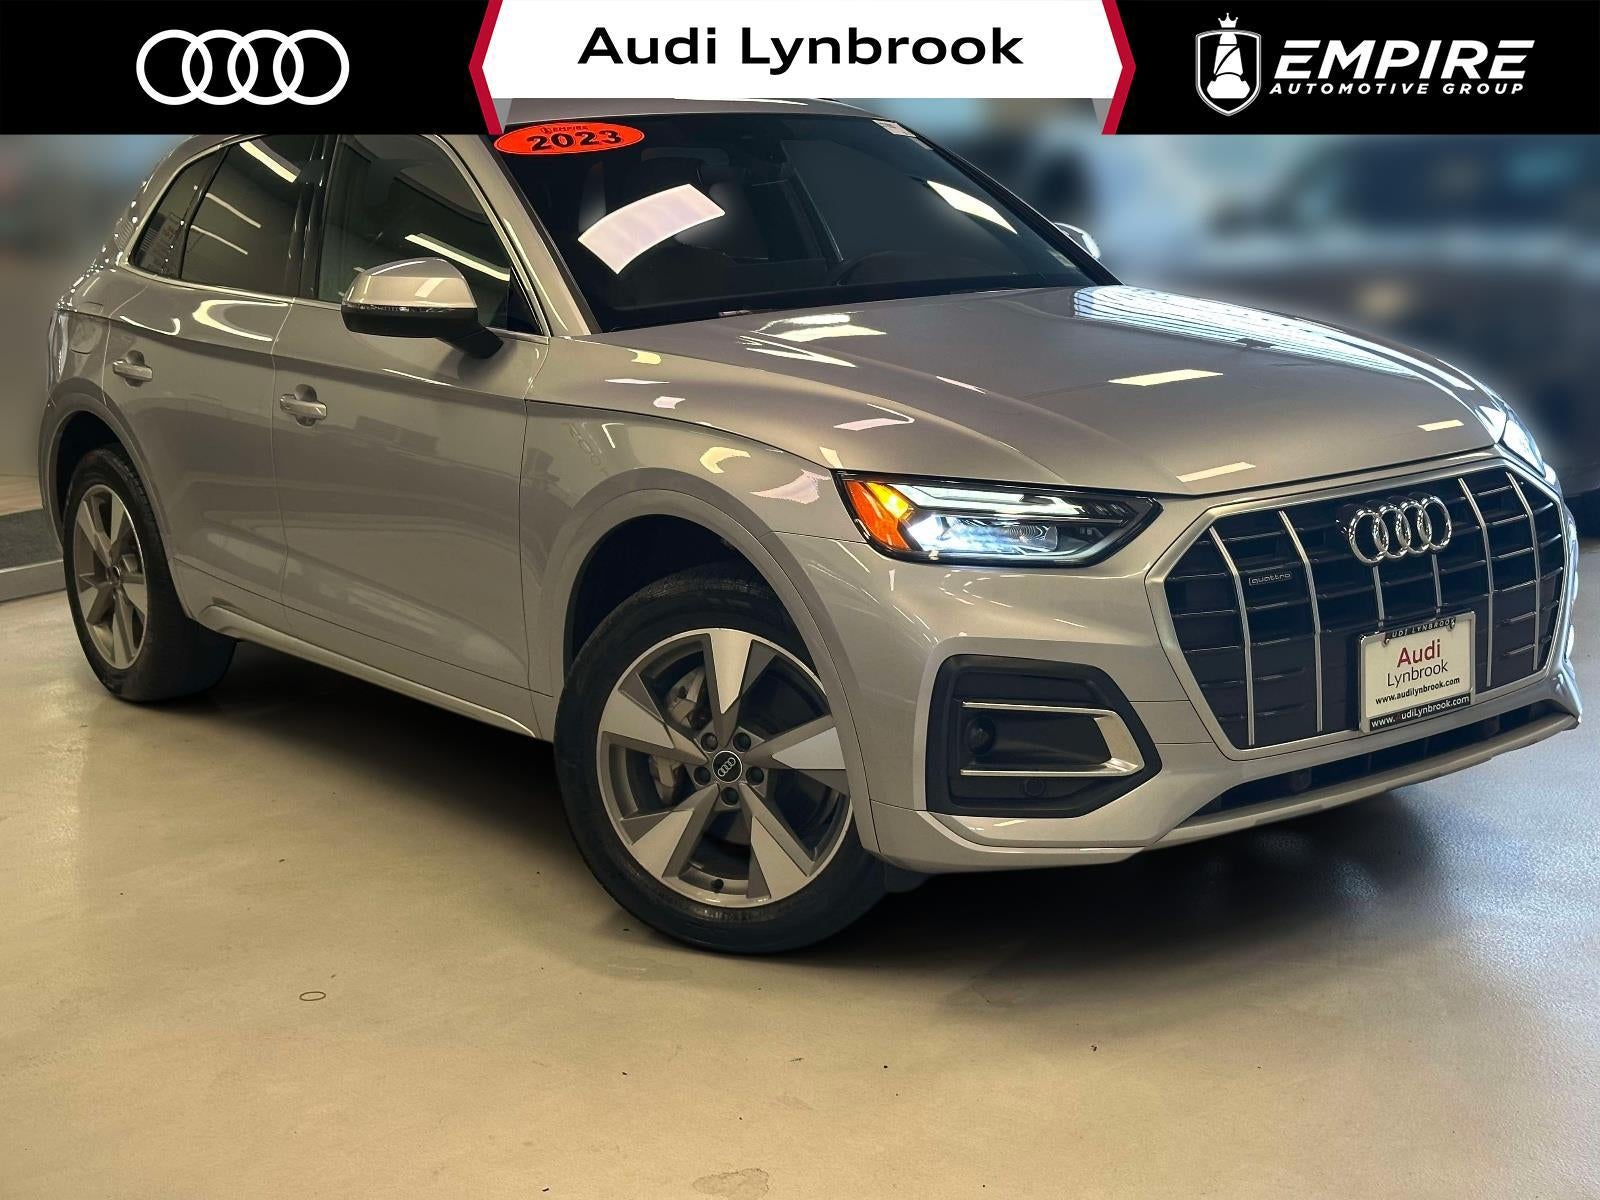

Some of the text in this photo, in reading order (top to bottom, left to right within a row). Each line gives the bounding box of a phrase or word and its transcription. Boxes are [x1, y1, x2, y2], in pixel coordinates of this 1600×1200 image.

[526, 130, 622, 151] 2023
[1250, 573, 1291, 585] quattro
[1397, 639, 1441, 667] Audi
[1387, 659, 1449, 688] Lynbrook
[1375, 677, 1460, 705] www.audilynbrook.com
